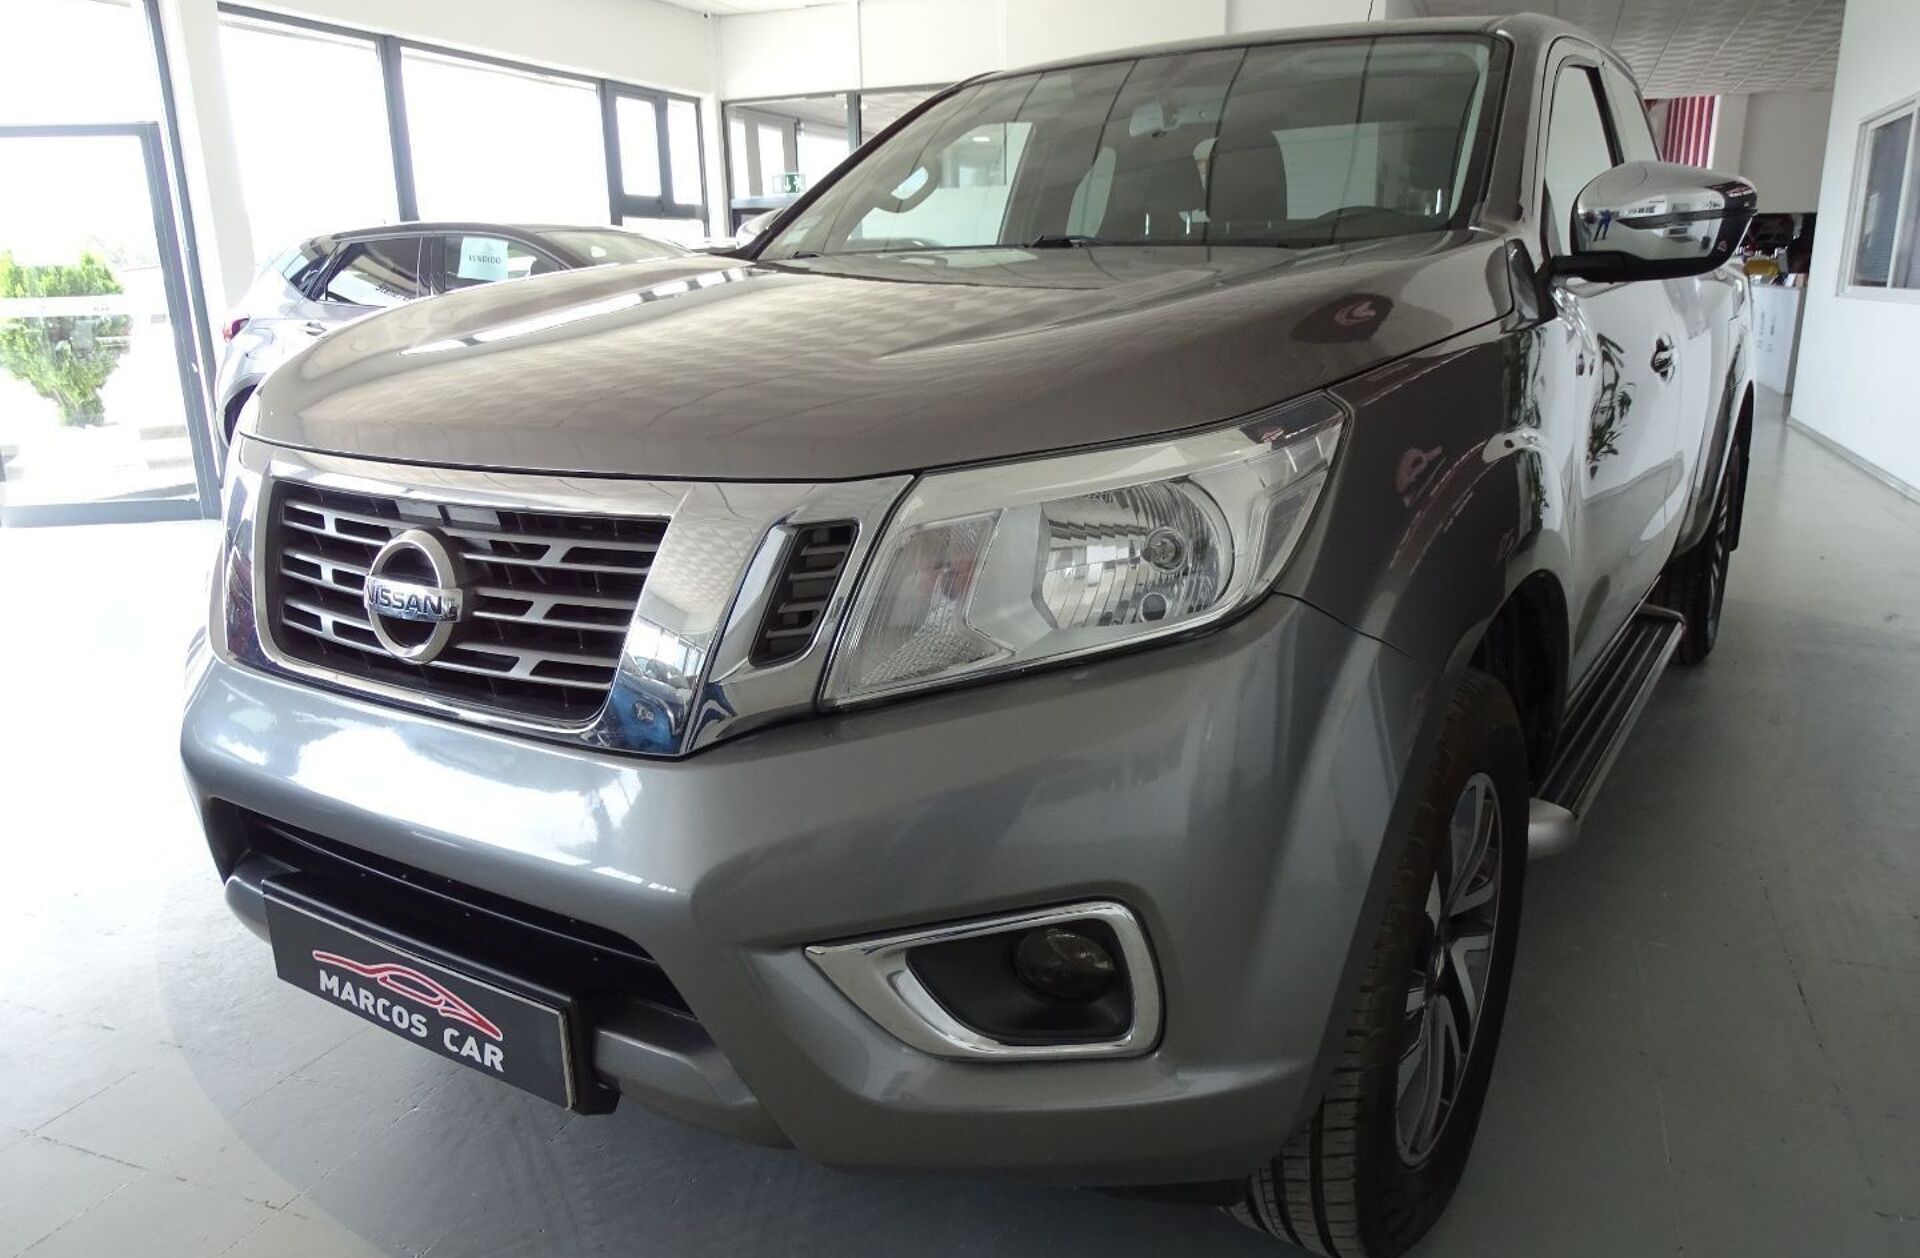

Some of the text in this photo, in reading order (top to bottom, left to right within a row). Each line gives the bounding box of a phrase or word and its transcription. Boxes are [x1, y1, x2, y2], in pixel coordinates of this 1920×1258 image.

[468, 255, 501, 265] VENDIDO
[319, 969, 504, 1072] MARCOS CAR
